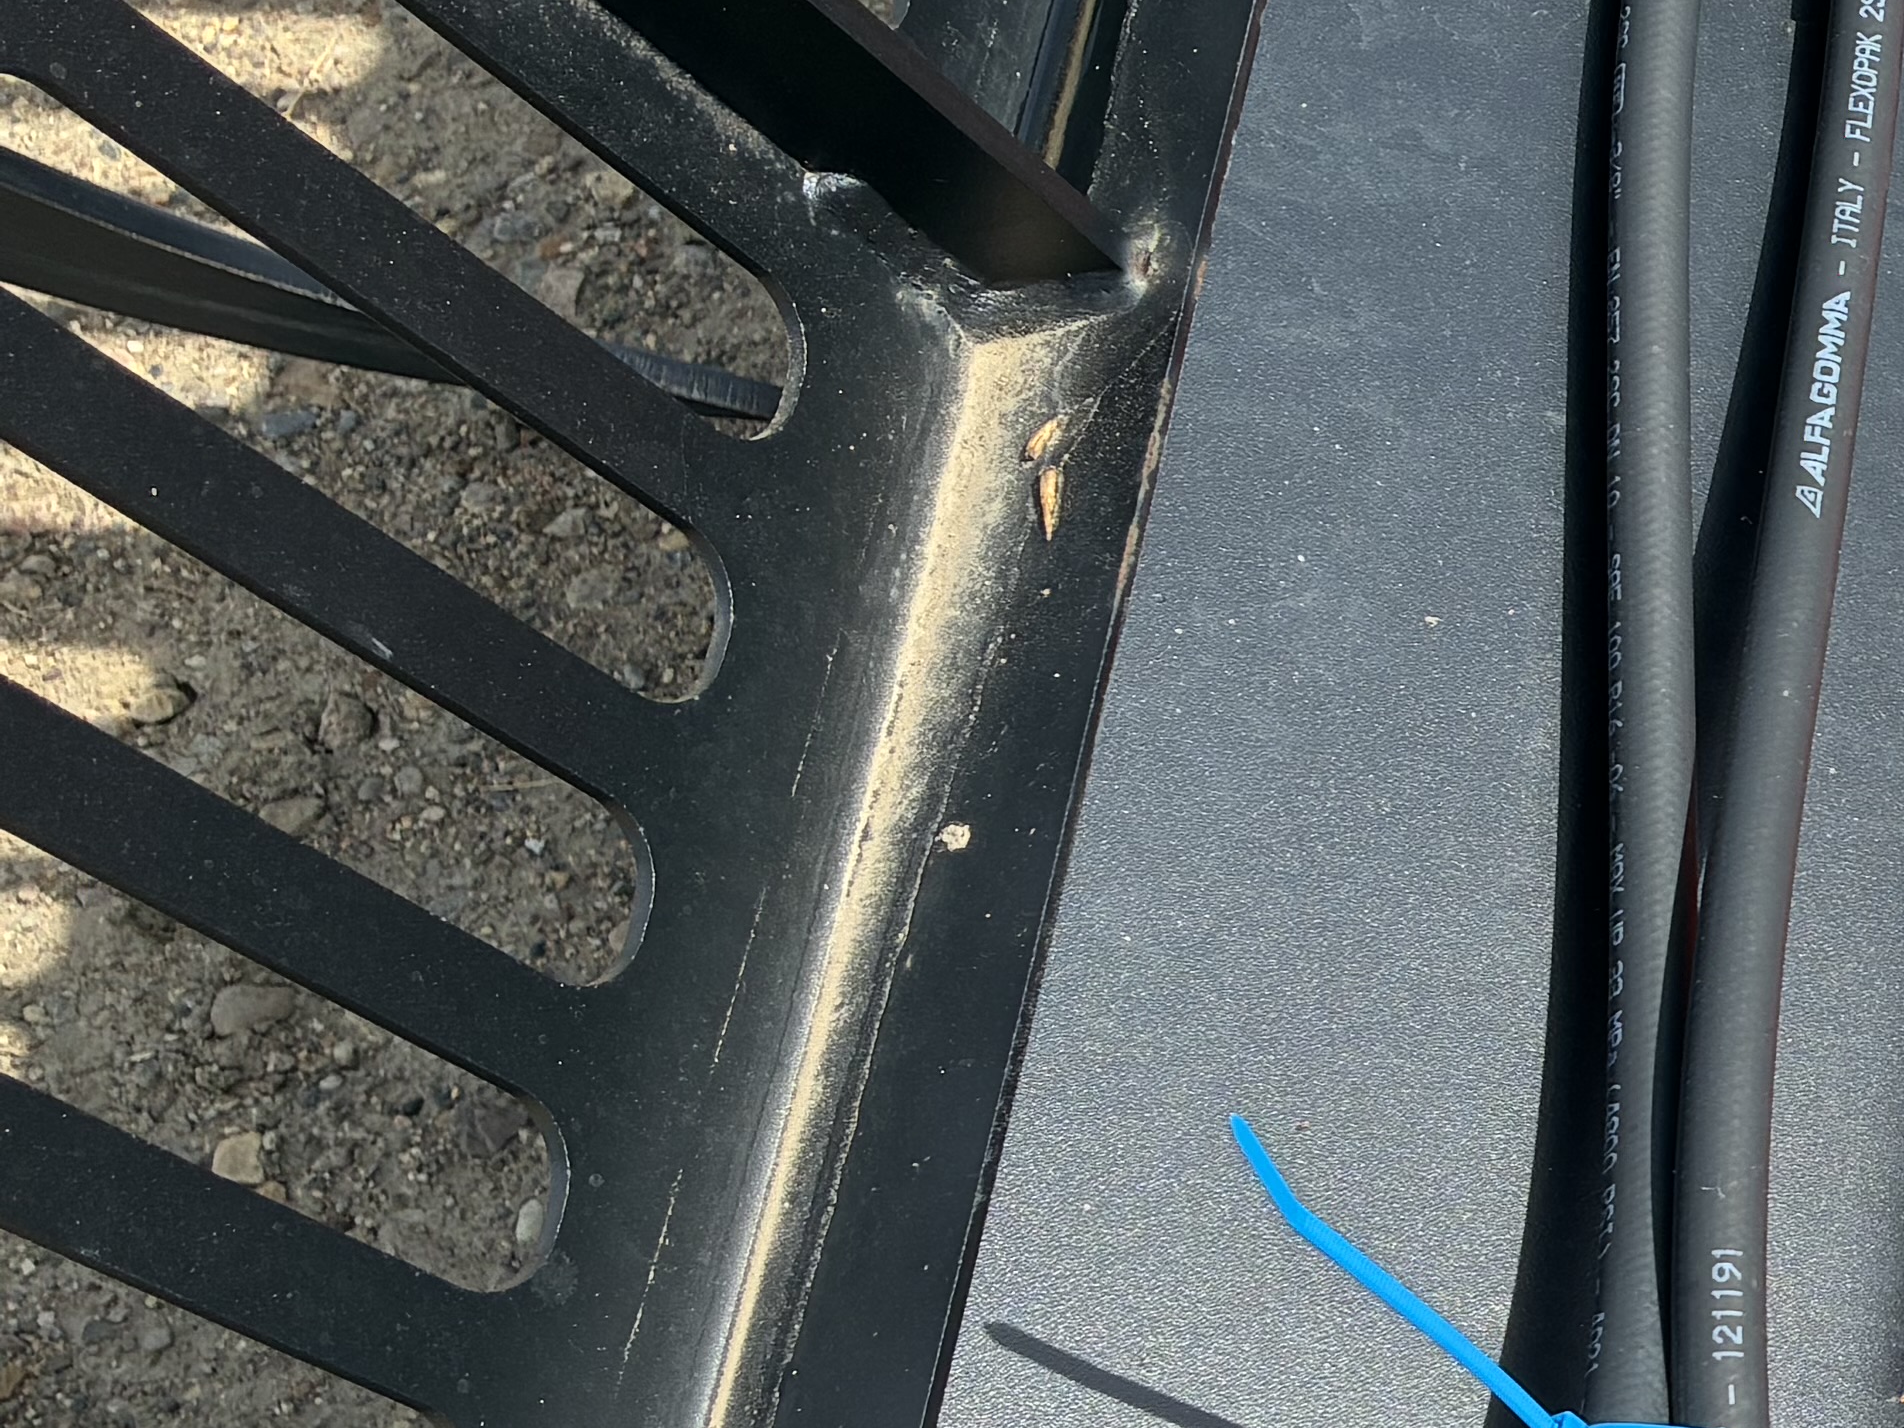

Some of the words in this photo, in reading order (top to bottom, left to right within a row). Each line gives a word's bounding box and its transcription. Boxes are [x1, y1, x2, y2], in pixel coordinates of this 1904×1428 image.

[1844, 32, 1883, 143] FLEXOPAK
[1830, 177, 1865, 248] ITALY
[1802, 290, 1851, 487] ALFAGOMMA
[1710, 1248, 1745, 1361] 121191
